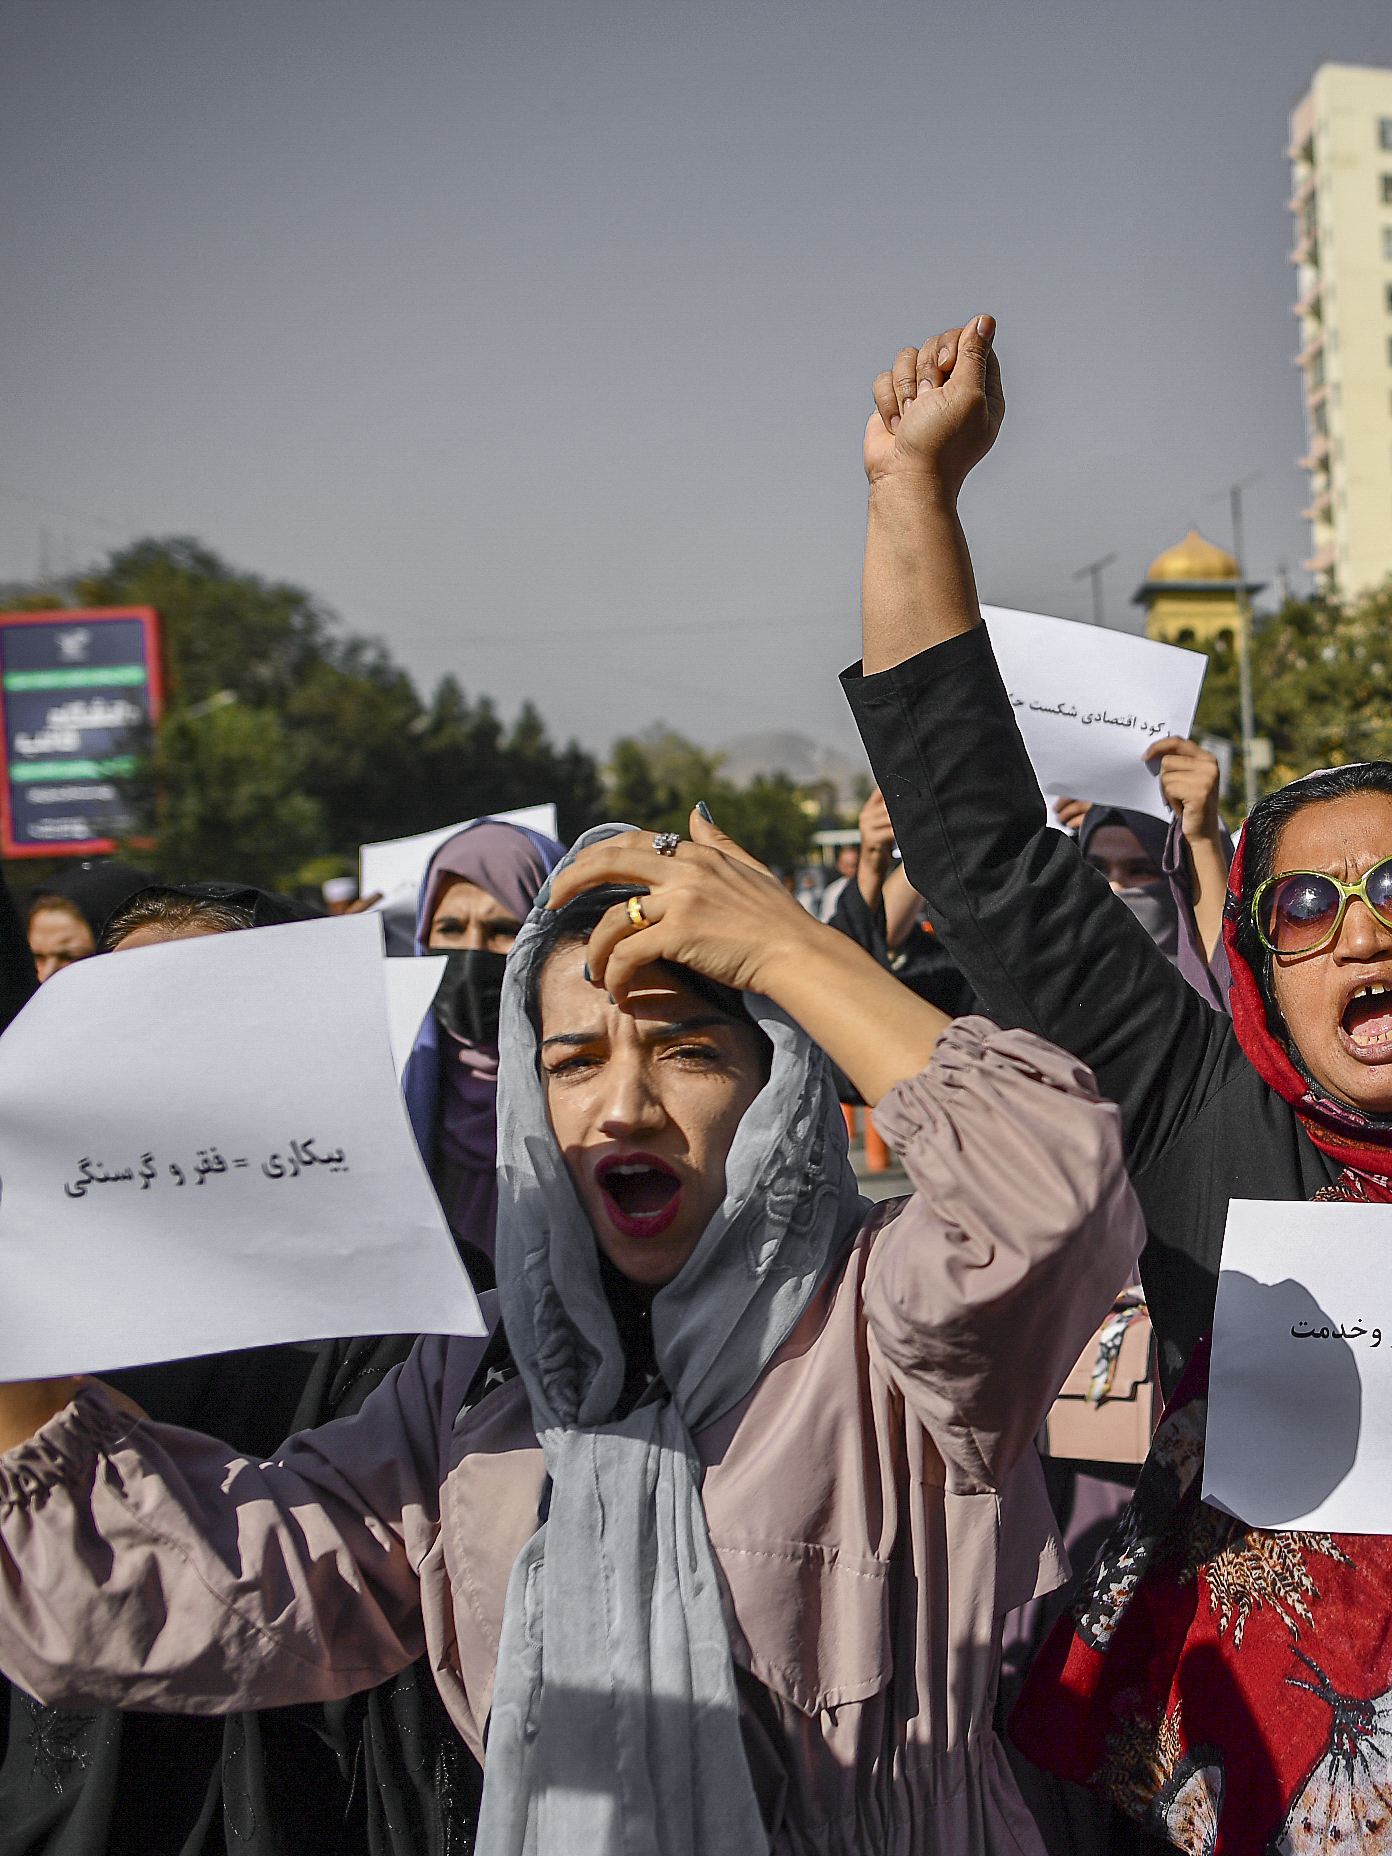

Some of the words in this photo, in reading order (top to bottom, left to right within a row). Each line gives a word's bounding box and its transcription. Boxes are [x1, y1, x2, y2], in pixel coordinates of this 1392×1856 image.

[1029, 700, 1078, 718] شکست
[1081, 710, 1138, 728] اقتصادی
[261, 1137, 350, 1180] بیکاری
[64, 1152, 158, 1199] گرسنگی
[168, 1163, 187, 1187] و
